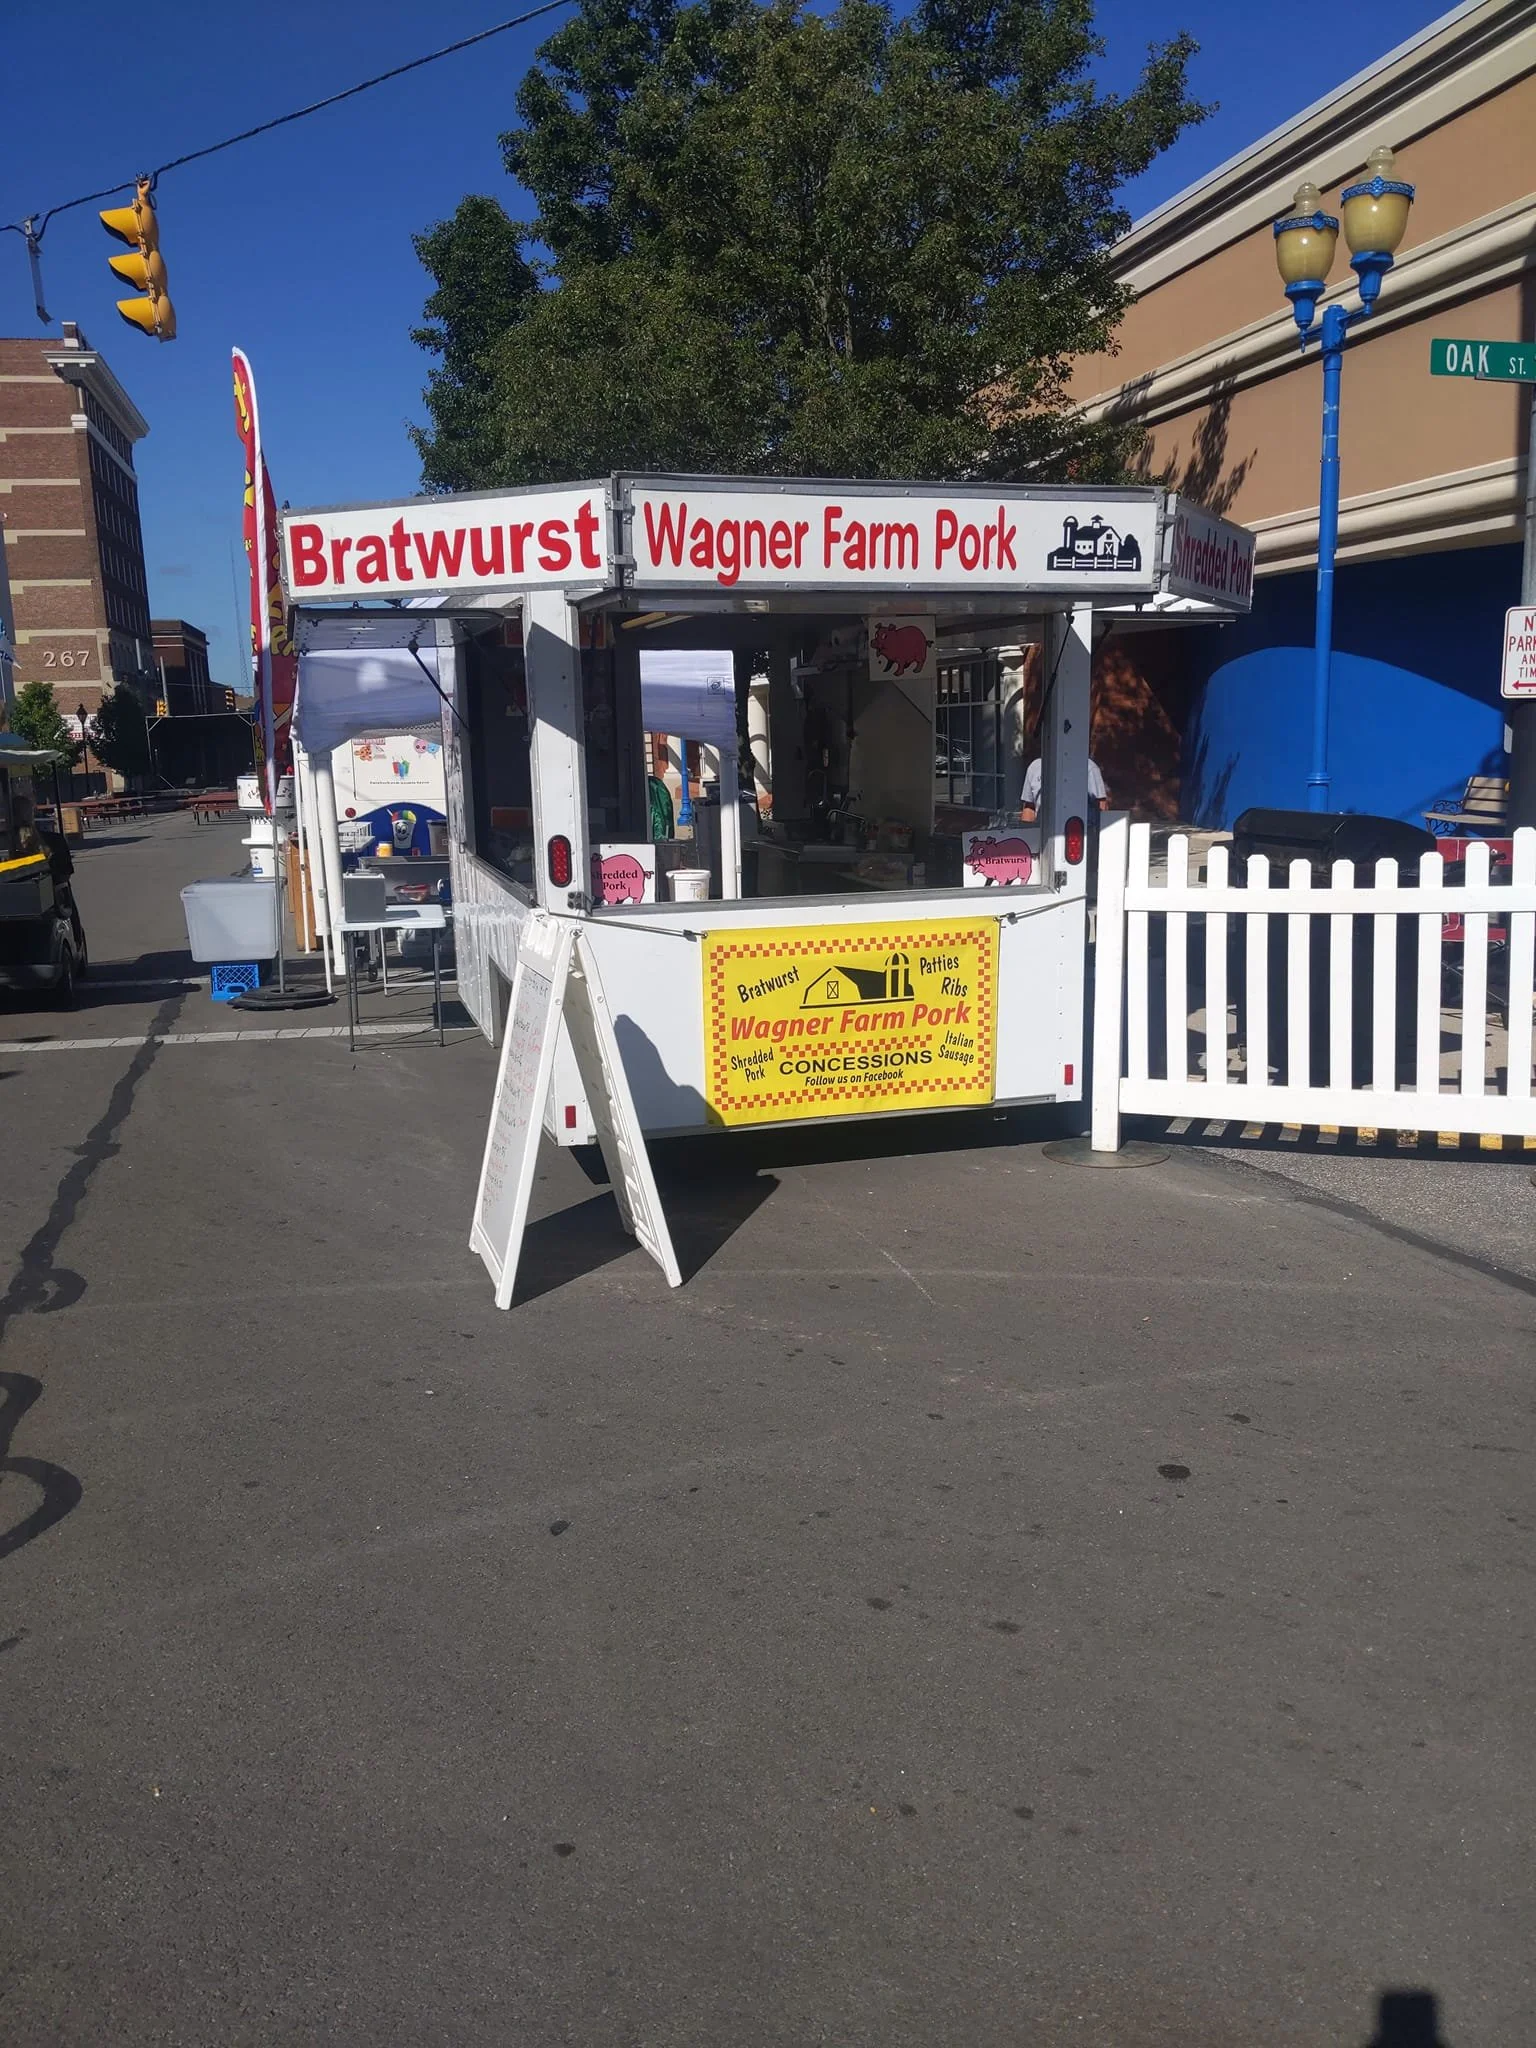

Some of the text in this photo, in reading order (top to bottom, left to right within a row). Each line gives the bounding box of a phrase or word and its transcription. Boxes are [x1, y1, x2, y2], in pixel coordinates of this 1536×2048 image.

[1446, 343, 1527, 375] OAK ST.
[289, 498, 601, 587] Bratwurst
[643, 501, 1017, 587] Wagner Farm Pork
[1173, 513, 1253, 598] Shredded Pork
[43, 650, 90, 668] 267
[985, 856, 1028, 865] Bratwurst
[603, 881, 627, 890] Pork
[919, 954, 959, 976] Patties
[737, 965, 800, 1004] Bratwurst
[941, 976, 968, 997] Ribs
[731, 1001, 971, 1043] Wagner Farm Pork
[945, 1030, 974, 1048] Italian
[731, 1047, 774, 1071] Shredded
[779, 1050, 933, 1075] CONCESSIONS
[938, 1044, 974, 1066] Sausage
[745, 1064, 766, 1083] Pork
[805, 1069, 904, 1087] Follow us on Facebook
